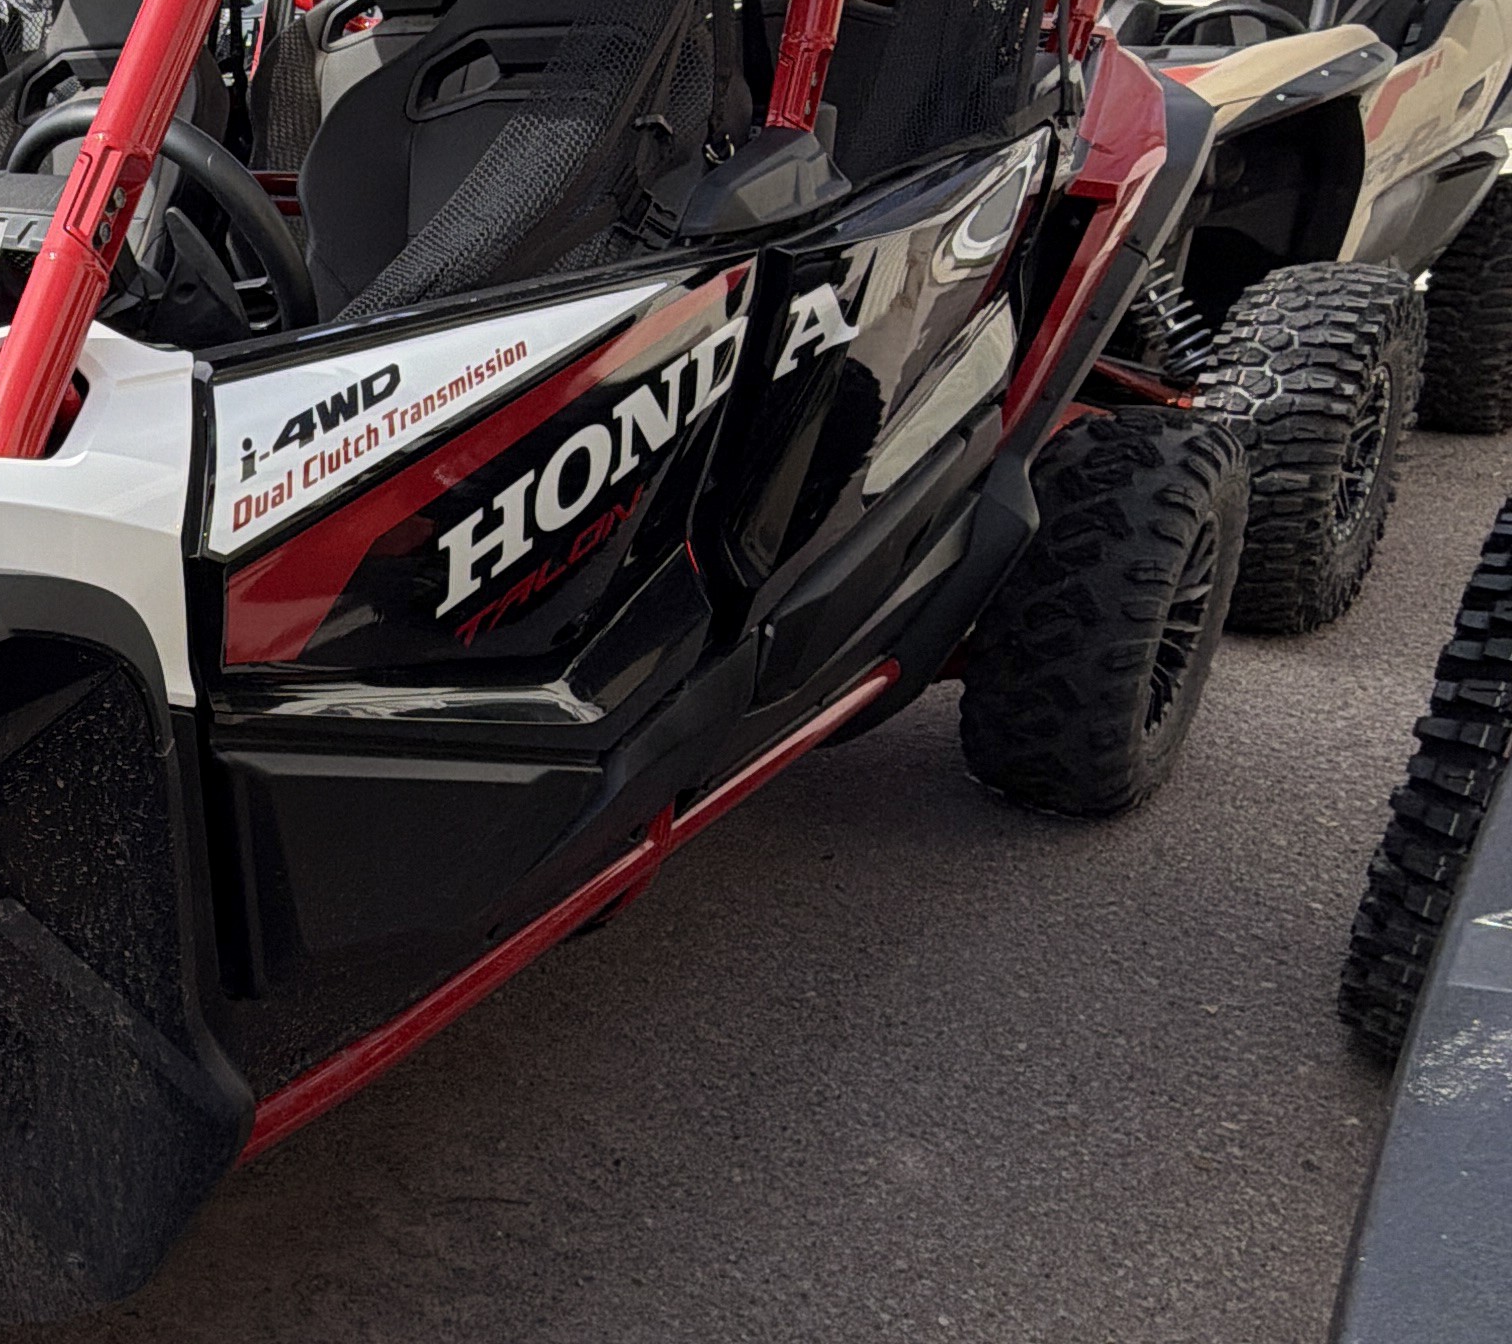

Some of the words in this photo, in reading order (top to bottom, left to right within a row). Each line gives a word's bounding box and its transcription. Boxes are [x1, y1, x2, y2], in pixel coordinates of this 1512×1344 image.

[233, 470, 293, 533] Dual
[303, 423, 380, 489] Clutch
[381, 340, 528, 439] Transmission
[436, 284, 860, 619] HONDA
[455, 483, 645, 649] TALON
